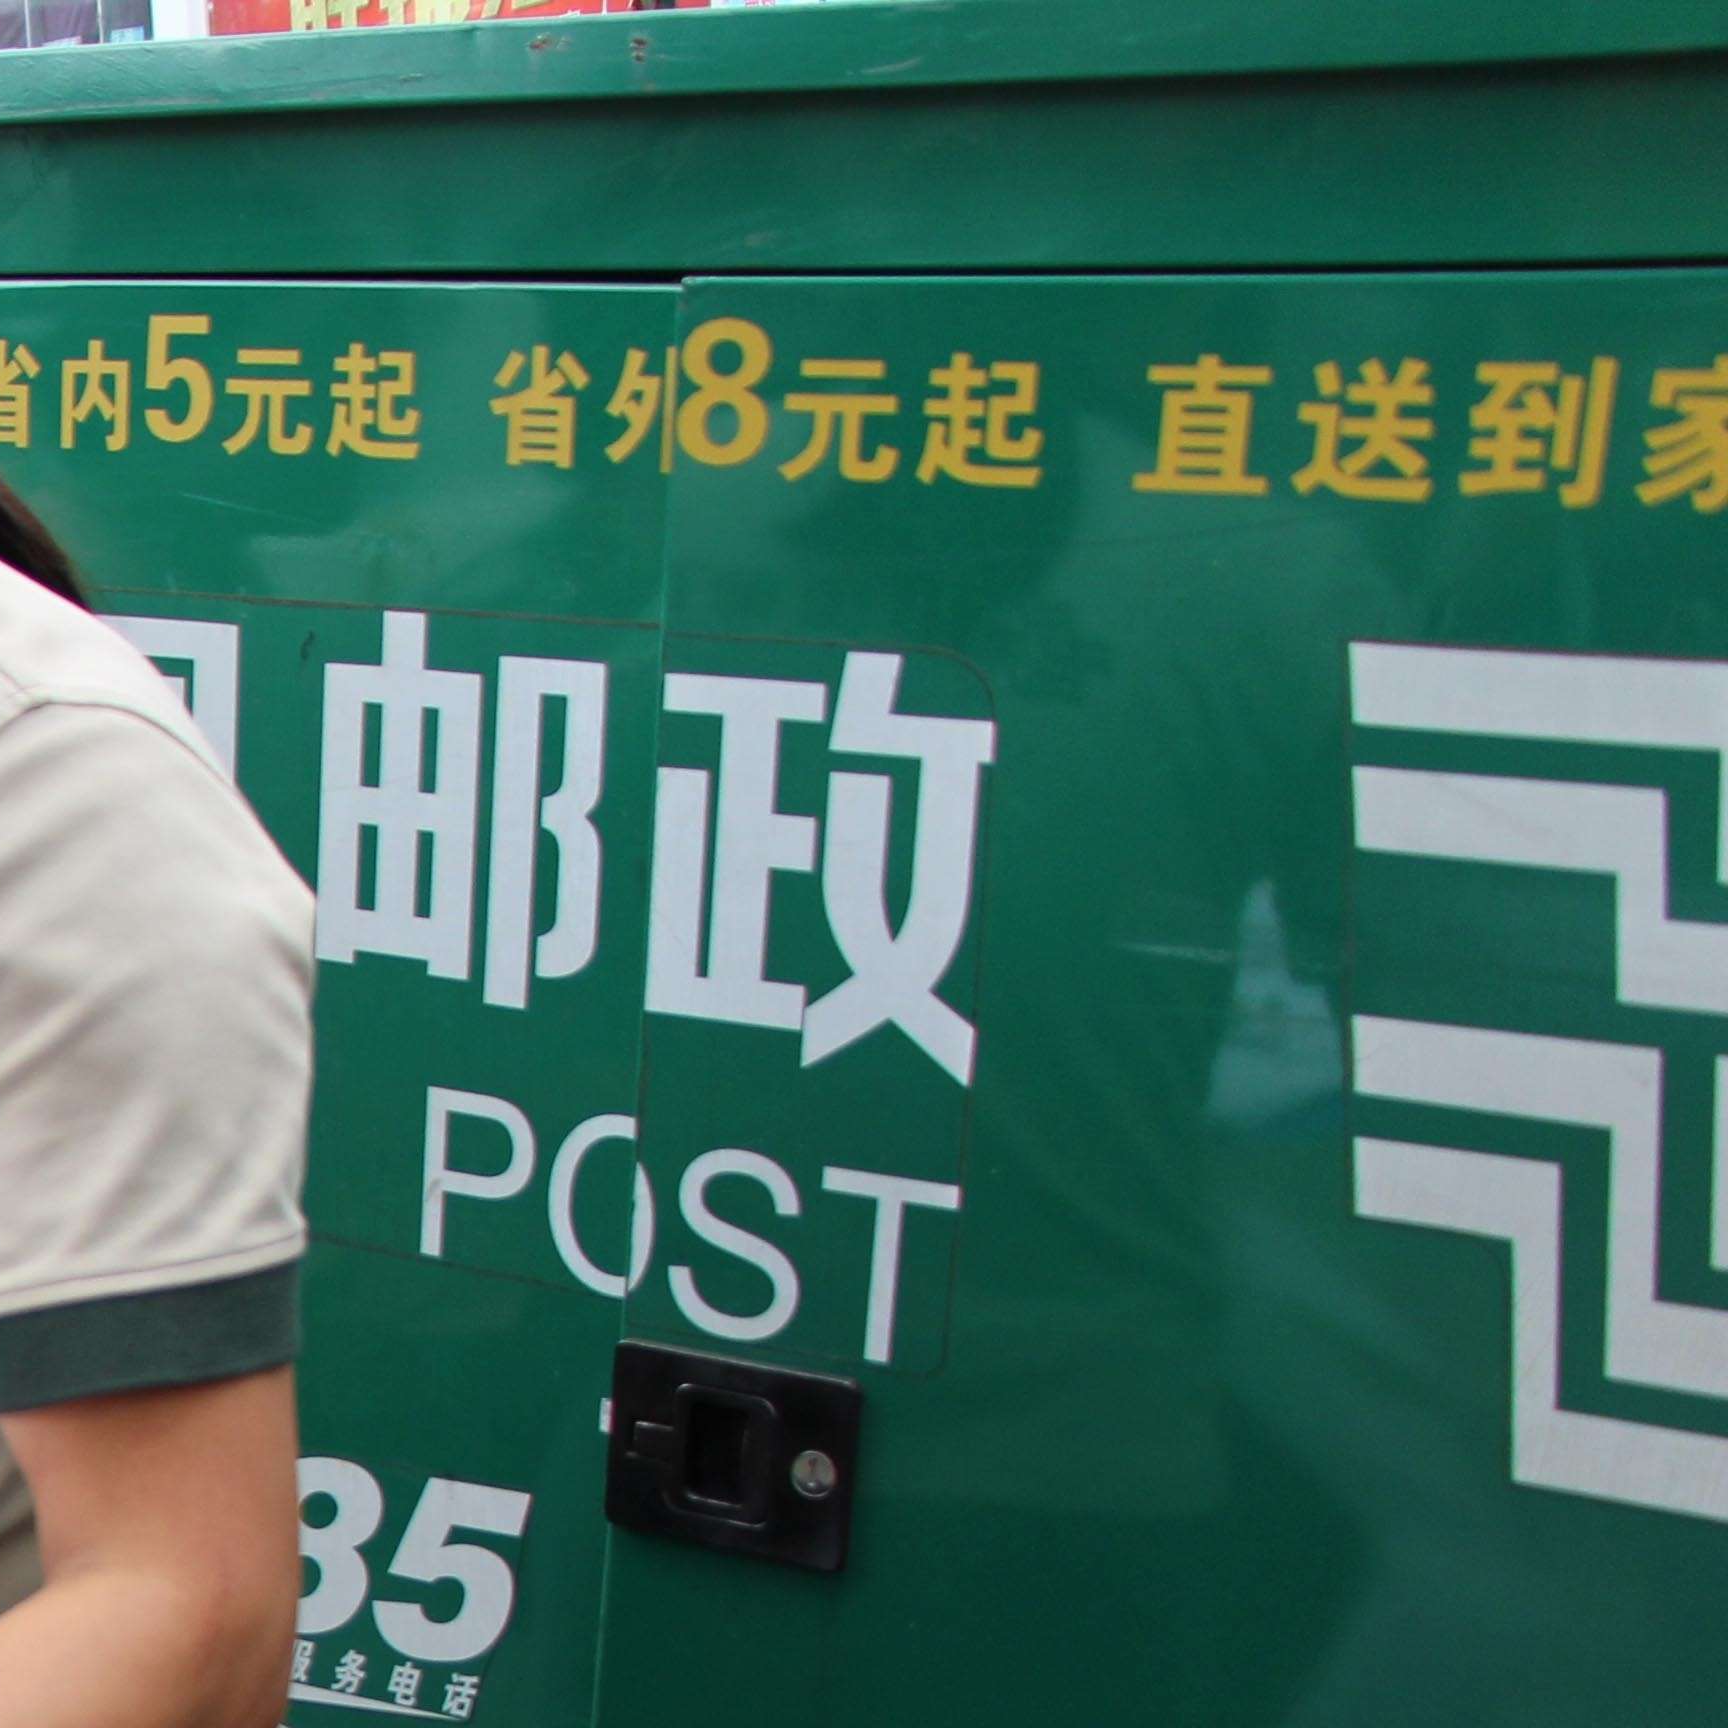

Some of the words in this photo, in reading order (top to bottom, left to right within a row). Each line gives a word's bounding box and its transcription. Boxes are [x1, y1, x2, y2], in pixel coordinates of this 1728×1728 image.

[490, 316, 1044, 486] 省外8元起
[1132, 354, 1728, 513] 直送到家
[419, 1085, 961, 1364] POST
